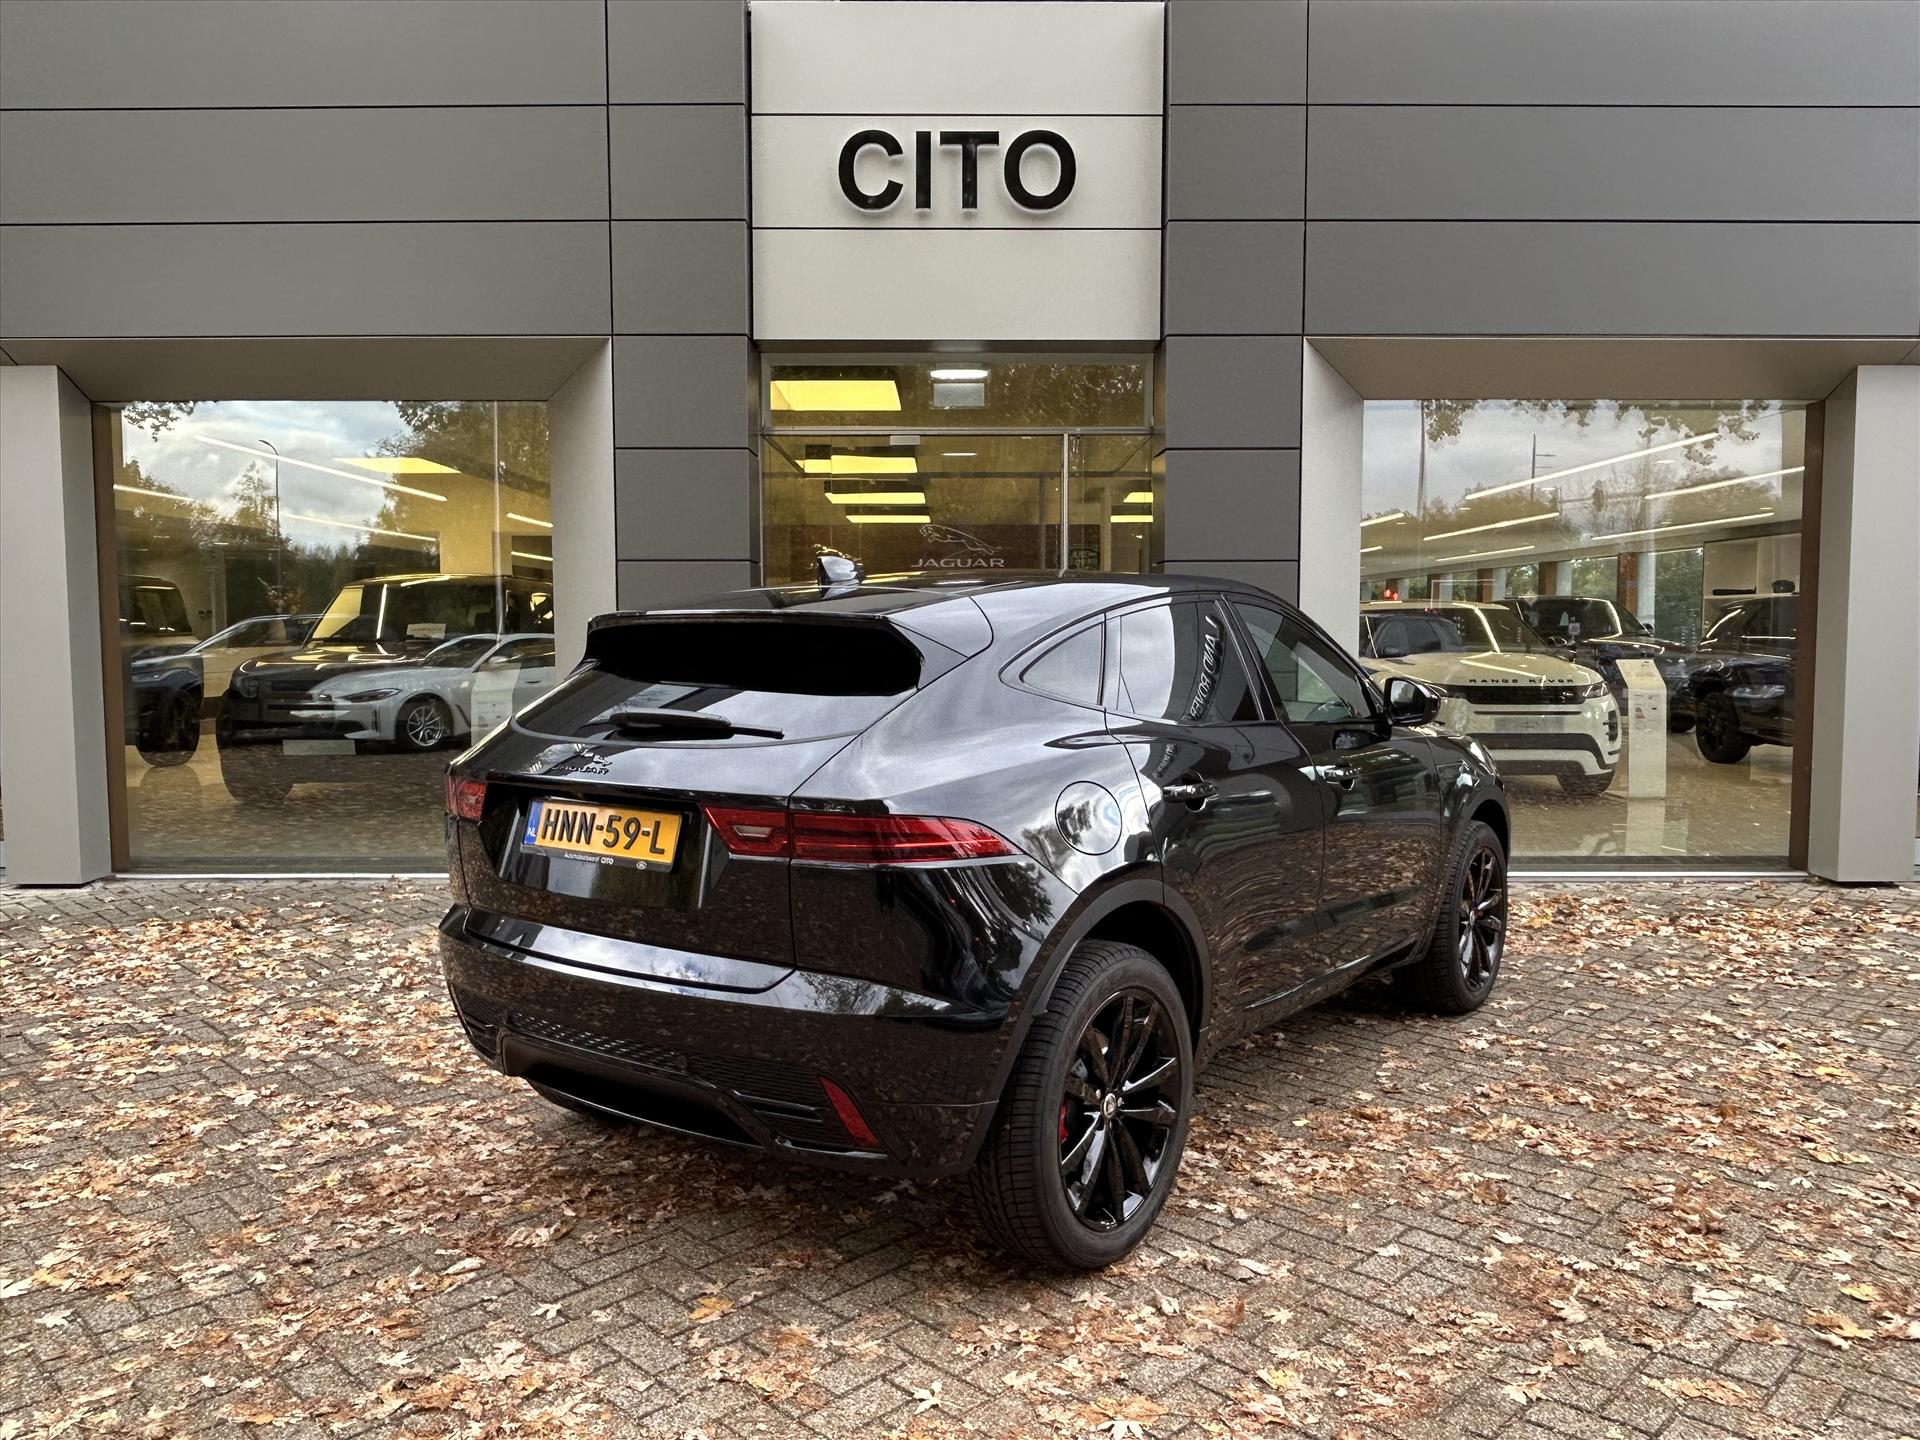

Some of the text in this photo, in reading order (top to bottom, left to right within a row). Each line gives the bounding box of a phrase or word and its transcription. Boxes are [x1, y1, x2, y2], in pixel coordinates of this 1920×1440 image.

[838, 129, 1076, 210] CITO
[910, 558, 1005, 568] JAGUAR
[527, 827, 537, 837] NL
[541, 808, 664, 855] HNN-59-L
